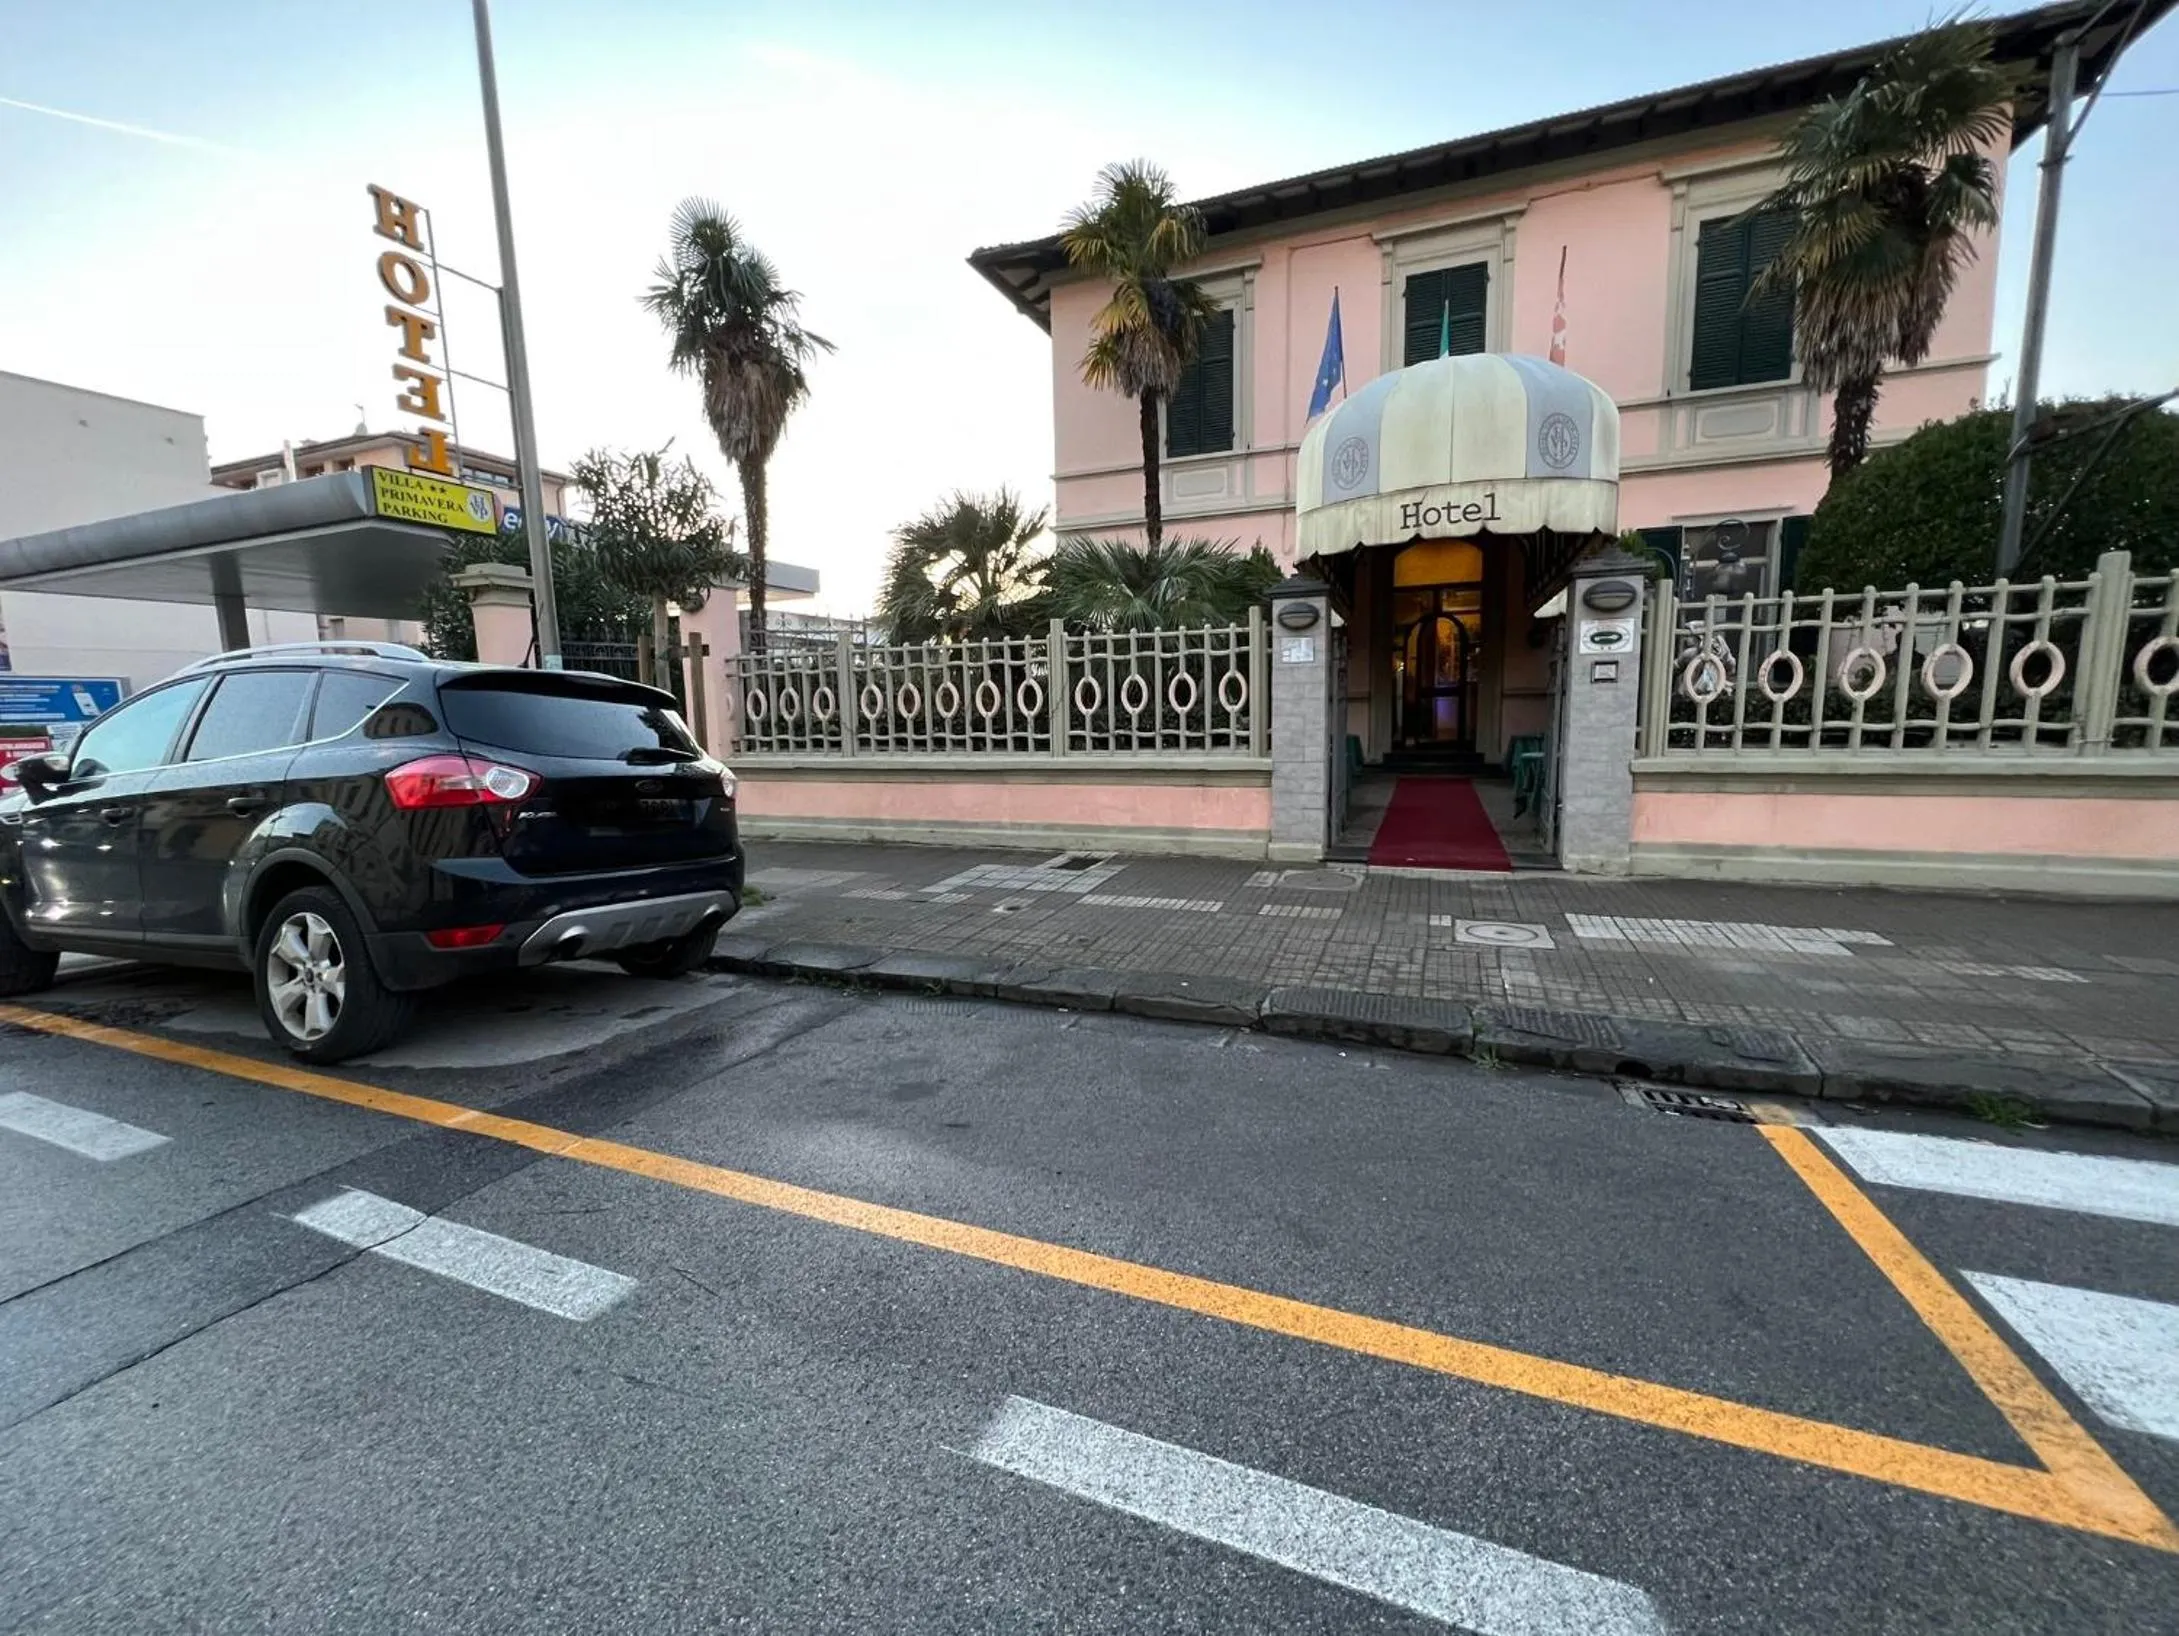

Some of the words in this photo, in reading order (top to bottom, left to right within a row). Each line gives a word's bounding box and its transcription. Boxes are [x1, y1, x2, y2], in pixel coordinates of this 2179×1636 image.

[379, 471, 423, 491] VILLA
[381, 487, 466, 513] PRIMAVERA
[1400, 493, 1502, 529] Hotel
[383, 502, 448, 524] PARKING
